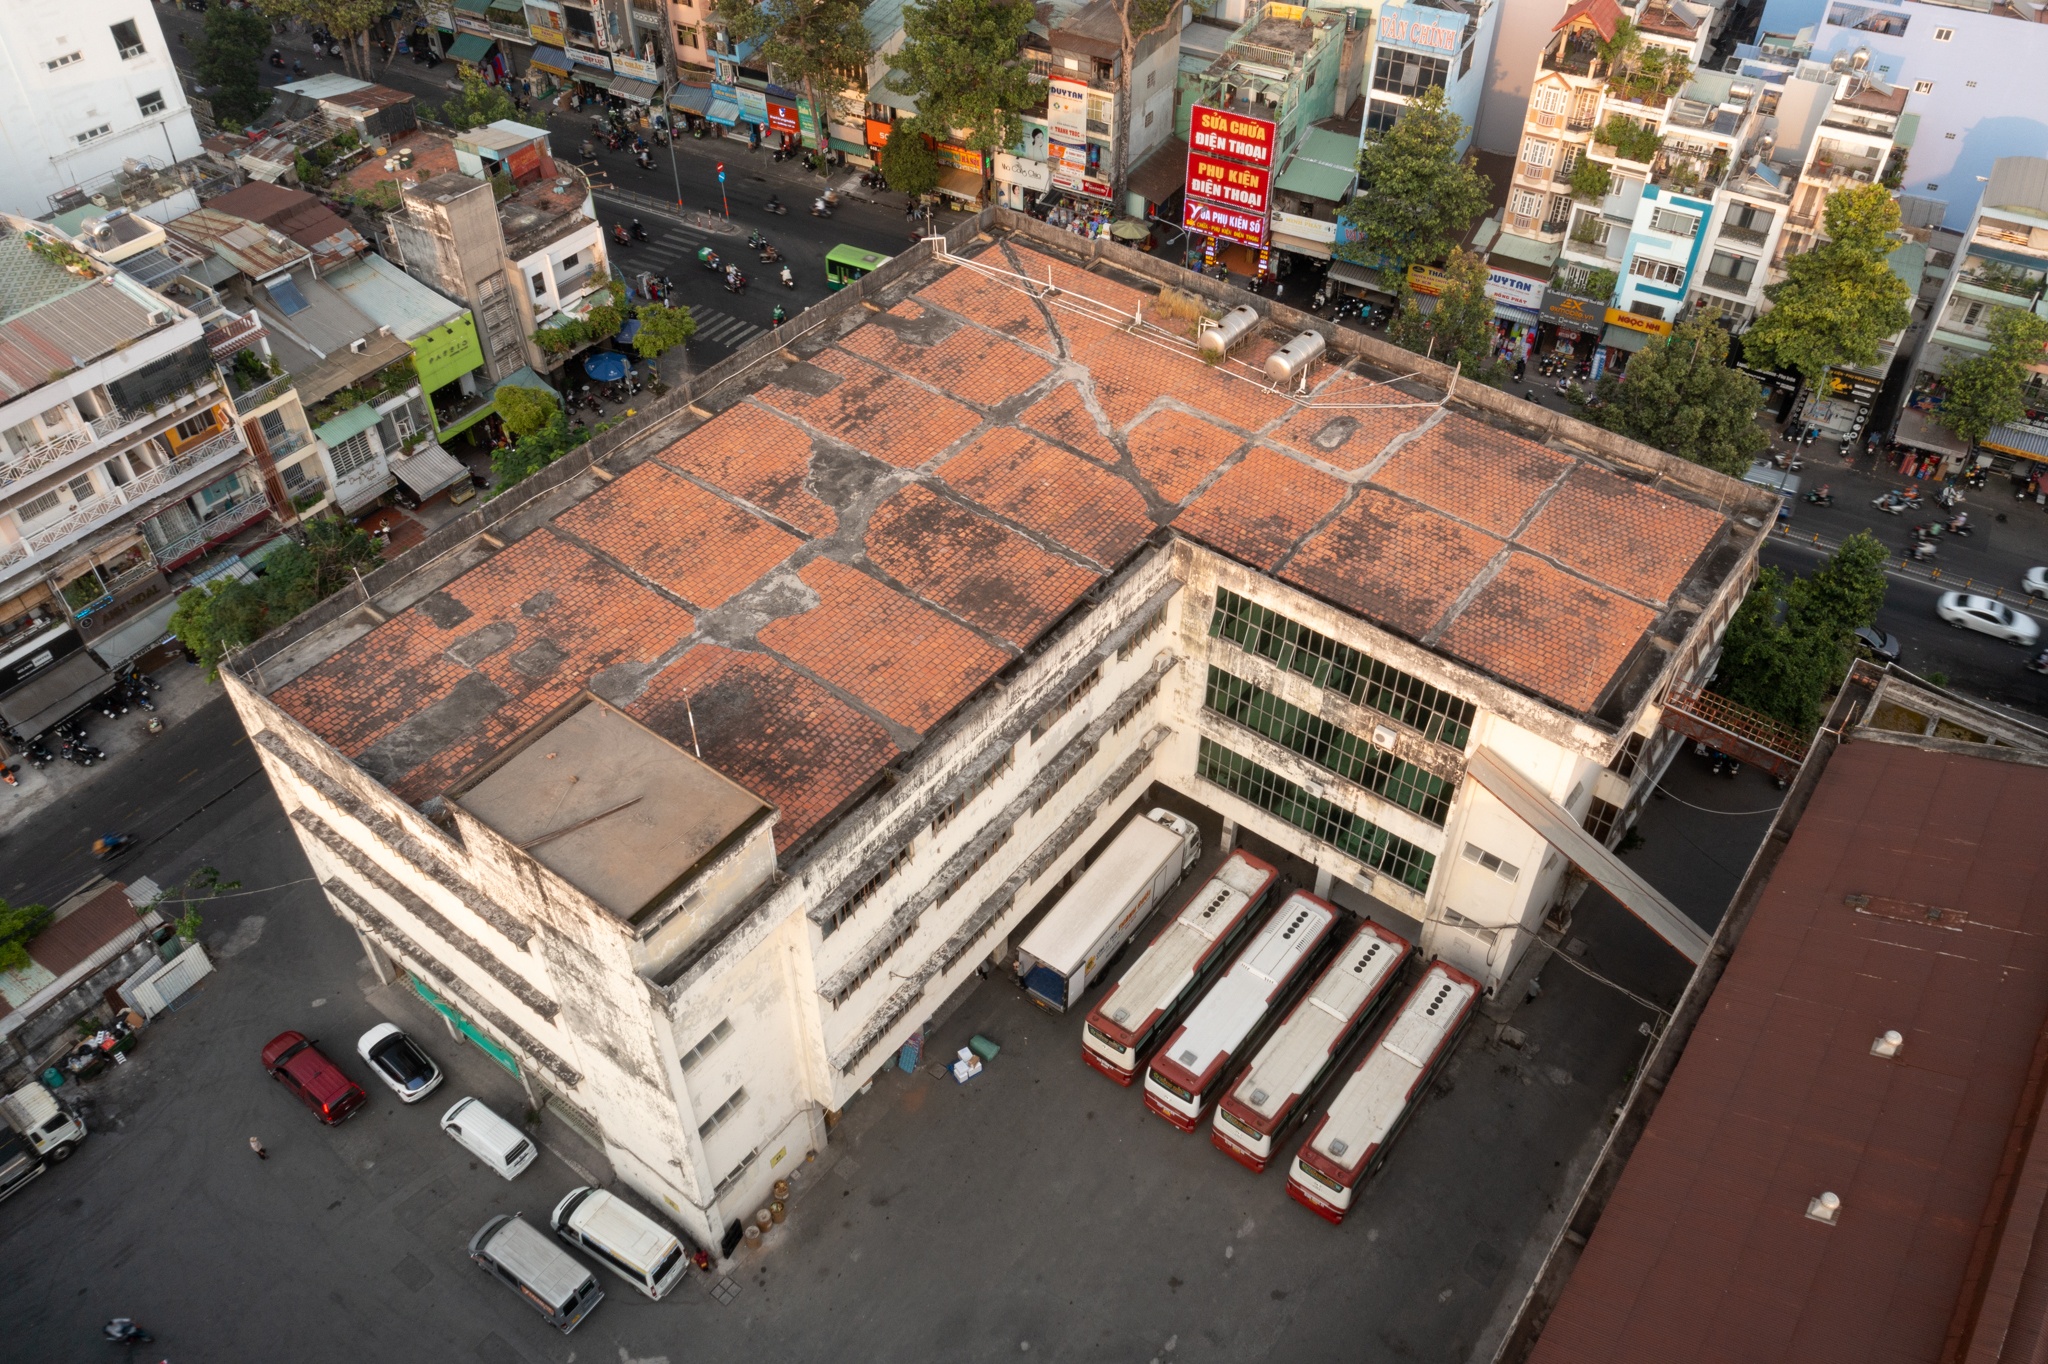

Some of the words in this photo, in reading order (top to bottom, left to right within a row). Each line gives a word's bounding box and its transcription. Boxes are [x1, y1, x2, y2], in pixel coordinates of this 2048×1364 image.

[1409, 21, 1456, 51] CHÍNH
[1201, 112, 1228, 132] SỬA
[1230, 121, 1266, 141] CHỮA
[1195, 131, 1226, 150] ĐIỆN
[1229, 139, 1267, 161] THOẠI
[1198, 162, 1225, 182] PHỤ
[1228, 170, 1259, 188] KIỆN
[1191, 178, 1221, 197] ĐIỆN
[1223, 186, 1262, 208] THOẠI
[1212, 211, 1228, 228] PHỤ
[1229, 215, 1248, 231] KIỆN
[1249, 219, 1261, 233] SỐ
[1617, 314, 1644, 328] NGỌC
[1645, 322, 1660, 332] NHI
